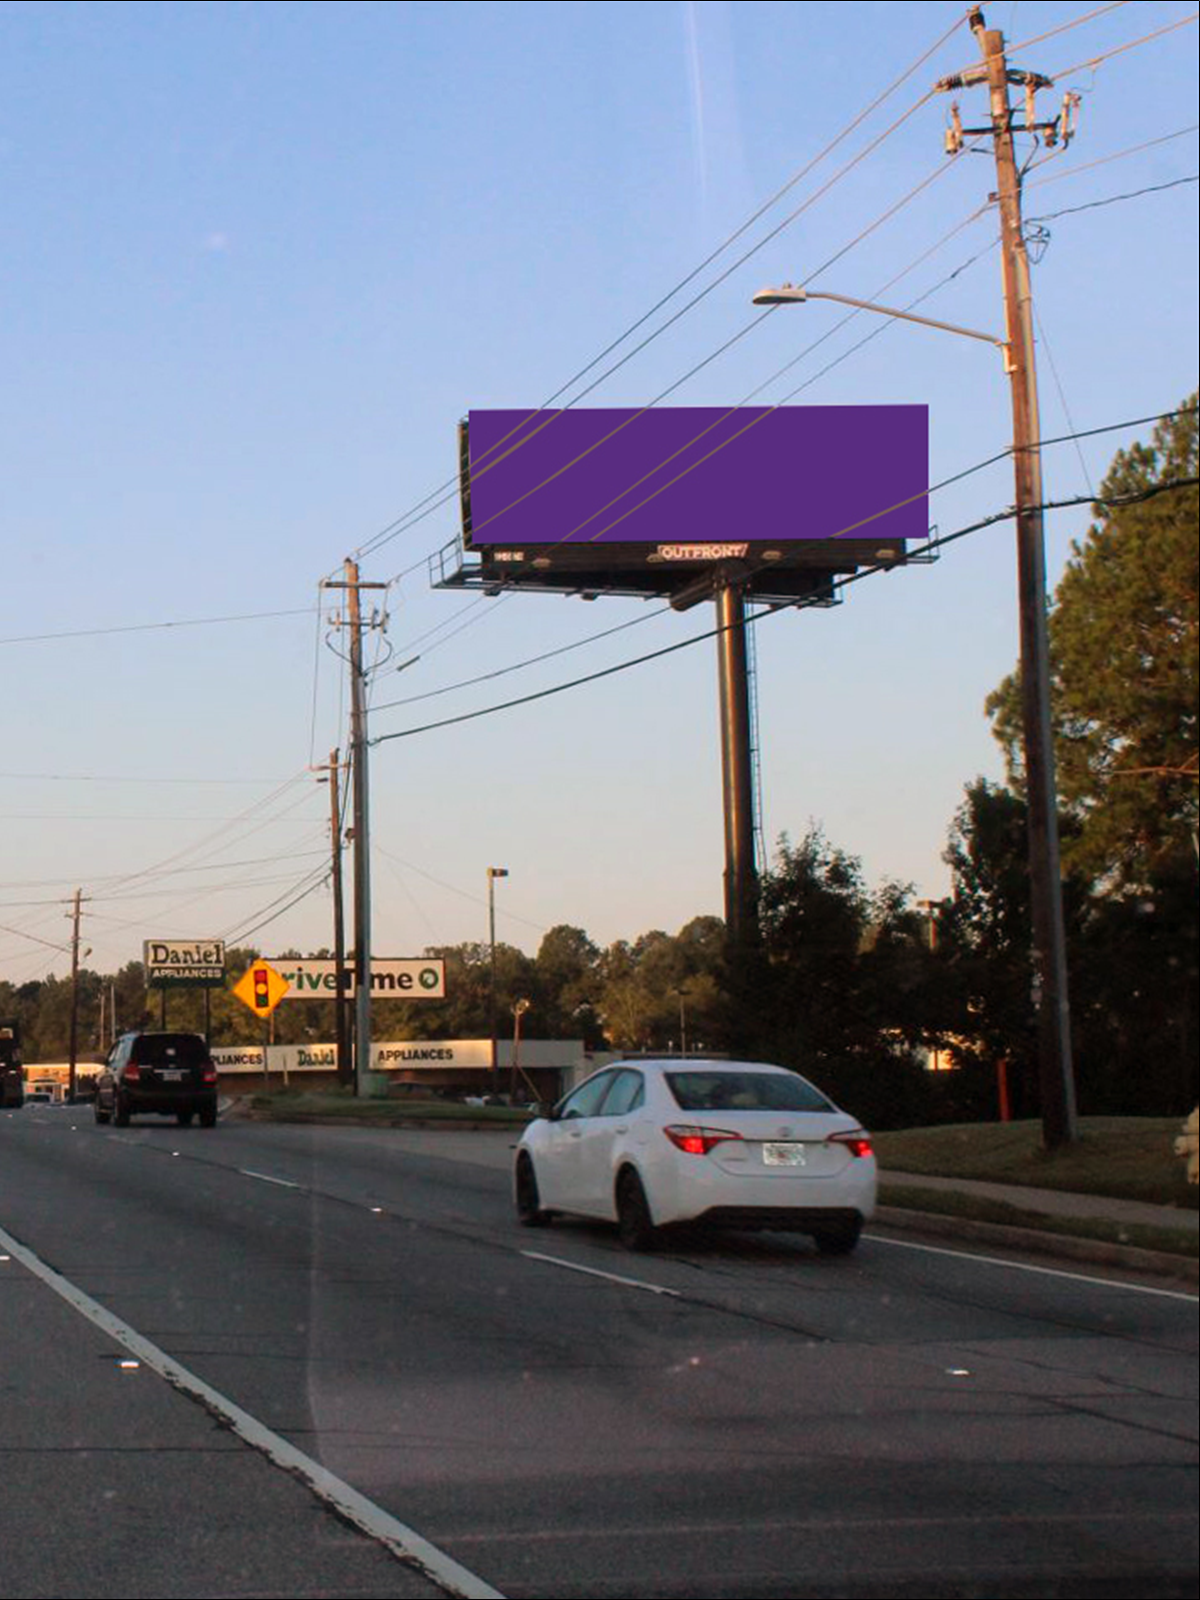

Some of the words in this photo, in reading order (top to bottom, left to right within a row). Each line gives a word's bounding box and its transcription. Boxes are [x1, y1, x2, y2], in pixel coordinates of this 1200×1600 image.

[151, 944, 222, 964] Daniel
[152, 968, 222, 979] APPLIANCES
[297, 1049, 335, 1066] Daniel
[378, 1048, 453, 1062] APPLIANCES
